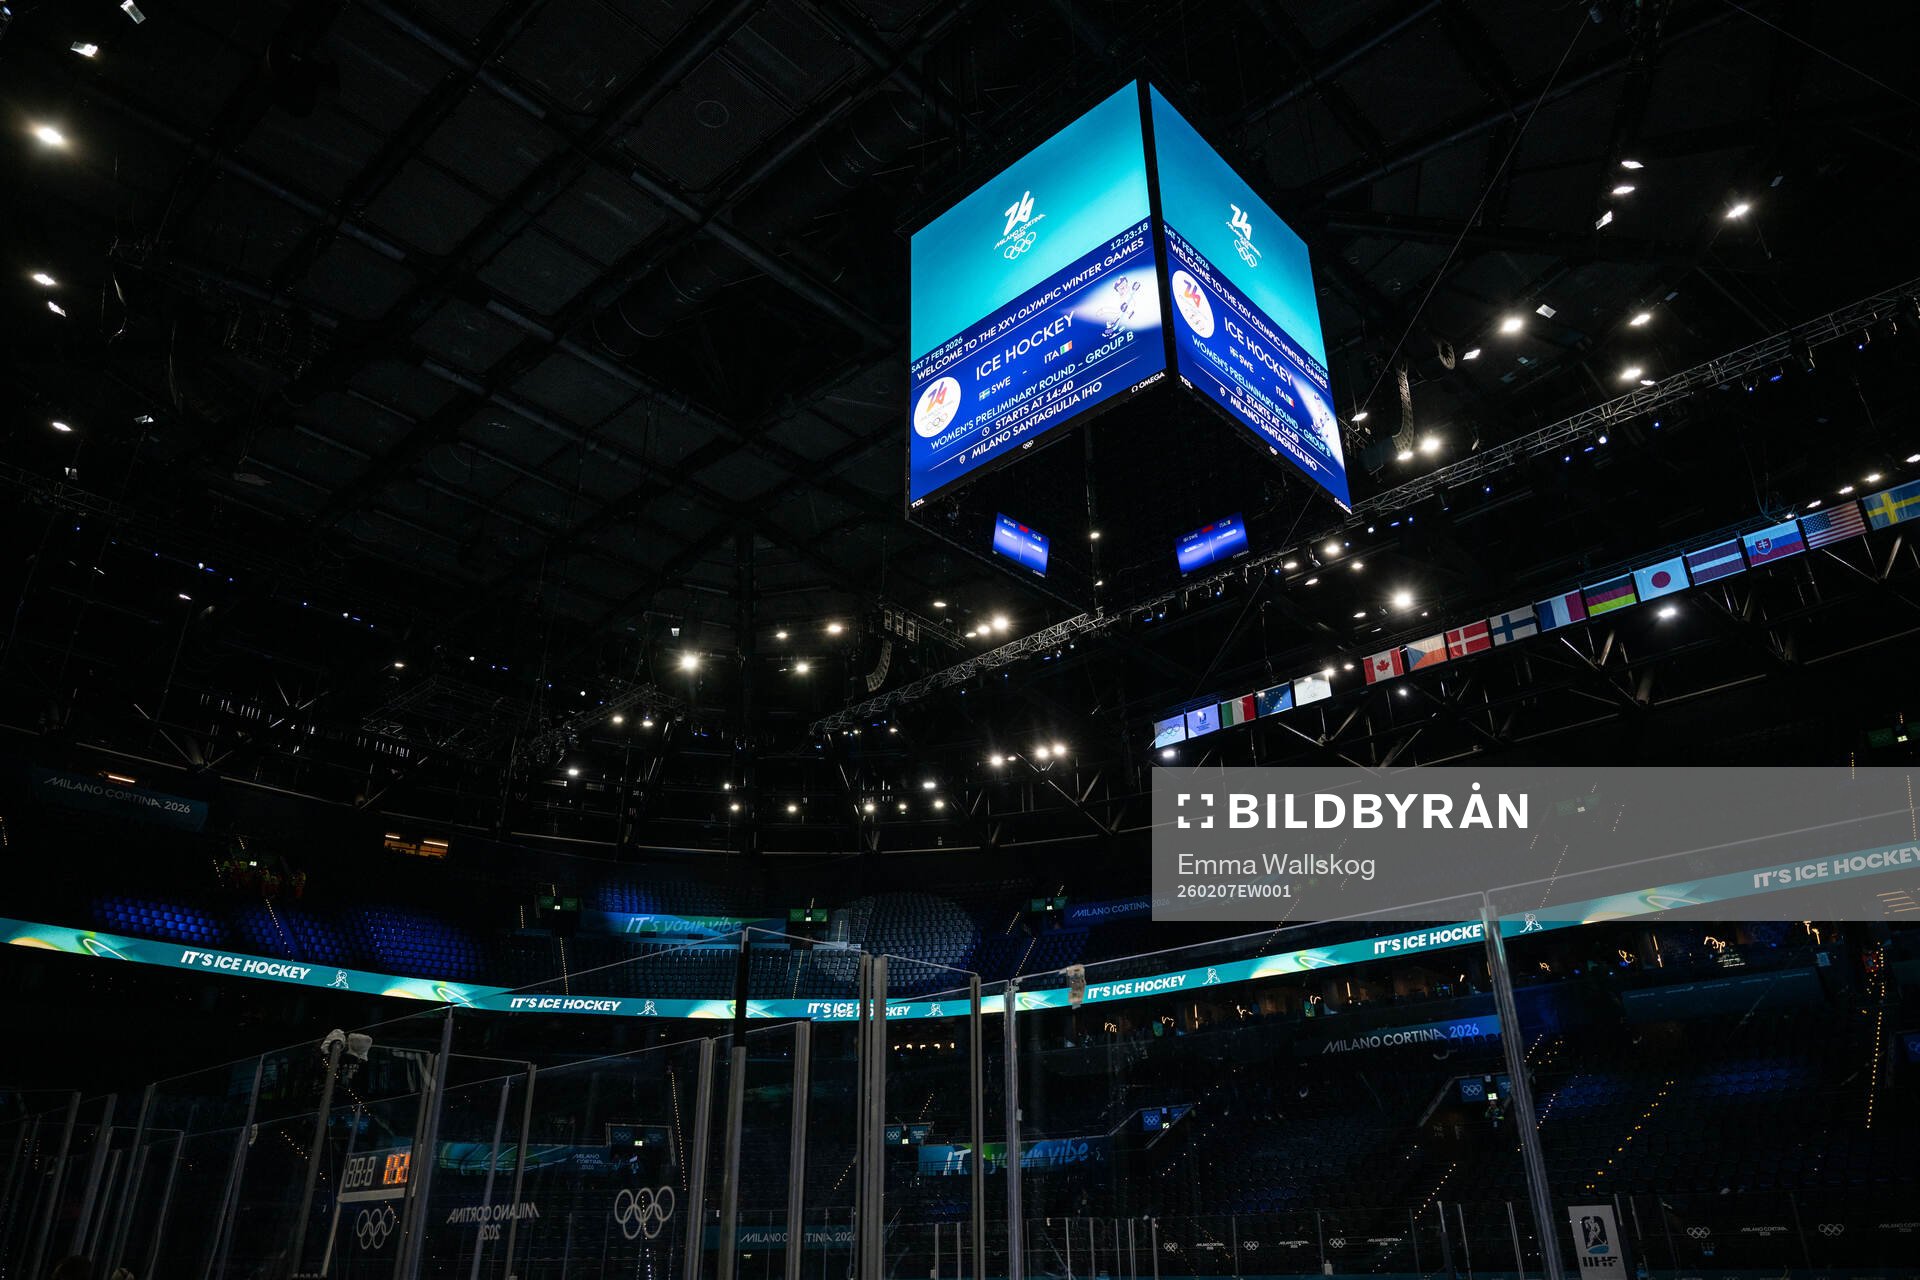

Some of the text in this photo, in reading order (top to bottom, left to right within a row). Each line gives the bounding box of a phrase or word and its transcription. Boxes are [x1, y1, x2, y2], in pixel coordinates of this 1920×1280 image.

[1110, 222, 1149, 251] 12:23:18
[1163, 225, 1176, 239] SAT
[1182, 242, 1194, 257] FEB
[1195, 253, 1210, 271] 2026
[917, 237, 1144, 380] WELCOME TO THE XXV OLYMPIC WINTER GAMES
[1170, 241, 1211, 284] WELCOME
[1211, 278, 1222, 293] TO
[1223, 288, 1237, 307] THE
[1251, 315, 1281, 346] OLYMPIC
[1281, 341, 1305, 369] WINTER
[1305, 363, 1328, 389] GAMES
[911, 361, 924, 373] SAT
[931, 348, 944, 361] FEB
[945, 336, 963, 352] 2026
[976, 310, 1075, 381] ICE HOCKEY
[1224, 317, 1293, 386] ICE HOCKEY
[991, 376, 1011, 395] SWE
[1044, 349, 1059, 364] ITA
[1139, 372, 1165, 388] OMEGA
[1180, 375, 1193, 389] TCL
[1191, 335, 1229, 372] WOMEN'S
[1229, 366, 1274, 409] PRELIMINARY
[1274, 403, 1299, 430] ROUND
[1239, 354, 1255, 373] SWE
[1275, 385, 1287, 400] ITA
[931, 420, 974, 450] WOMEN'S
[975, 383, 1037, 426] PRELIMINARY
[1039, 363, 1076, 390] ROUND
[1085, 335, 1125, 364] GROUP
[1126, 331, 1134, 343] B
[995, 380, 1074, 430] STARTS AT 14:40
[1246, 394, 1271, 420] STARTS
[971, 381, 1102, 459] MILANO SANTAGIULIA IHO
[1230, 395, 1259, 424] MILANO
[1260, 419, 1305, 463] SANTAGIULIA
[911, 499, 925, 508] TCL
[44, 776, 191, 814] MILANO CORTINA 2026
[1795, 861, 1828, 881] ICE
[1834, 846, 1920, 875] HOCKEY
[626, 916, 743, 934] IT's your vibe
[1072, 908, 1110, 918] MILANO
[1112, 900, 1151, 913] CORTINA
[1403, 934, 1426, 950] ICE
[214, 956, 242, 971] ICE
[243, 960, 311, 980] HOCKEY
[1112, 983, 1132, 996] ICE
[1134, 975, 1186, 993] HOCKEY
[538, 998, 561, 1009] ICE
[563, 999, 621, 1011] HOCKEY
[833, 1002, 855, 1018] ICE
[1322, 1023, 1480, 1054] MILANO CORTINA 2026
[740, 1232, 780, 1242] MILANO
[781, 1232, 833, 1242] CTINA
